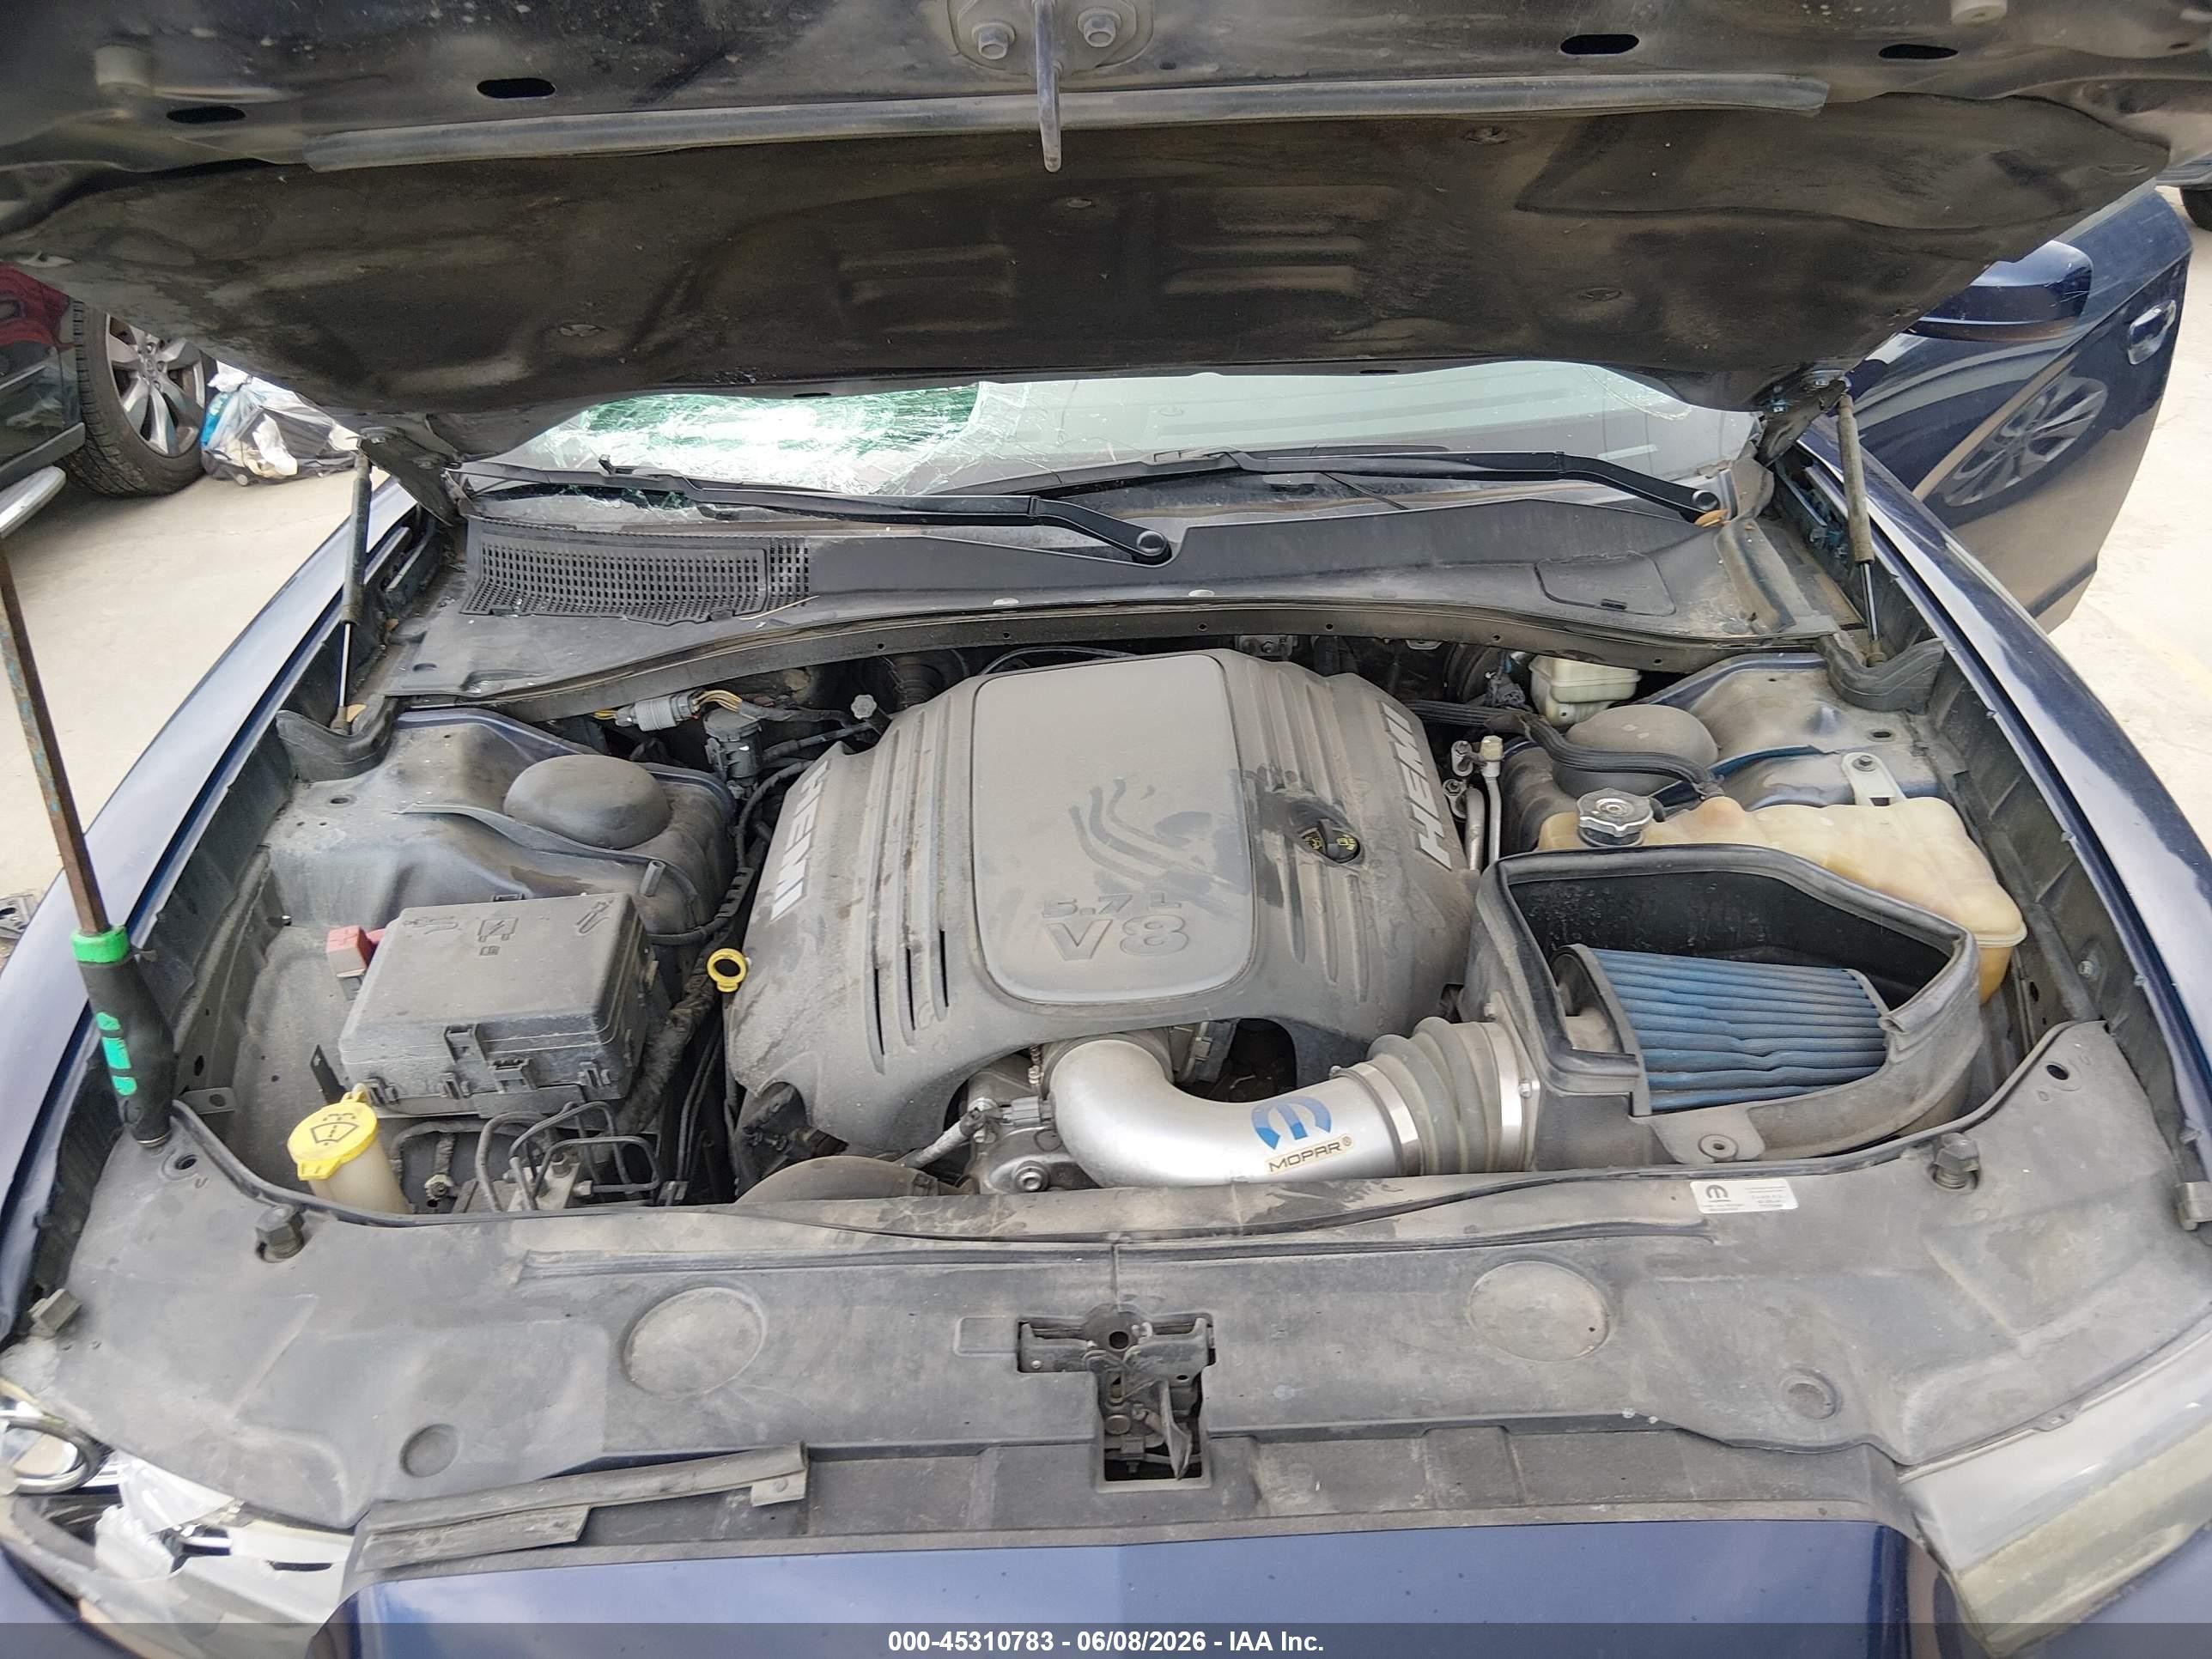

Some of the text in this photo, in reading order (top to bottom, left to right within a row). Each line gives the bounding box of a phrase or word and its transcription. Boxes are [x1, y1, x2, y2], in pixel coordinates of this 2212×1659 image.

[769, 759, 830, 921] HEMI
[1380, 701, 1453, 872] HEMI
[1045, 914, 1190, 962] V8
